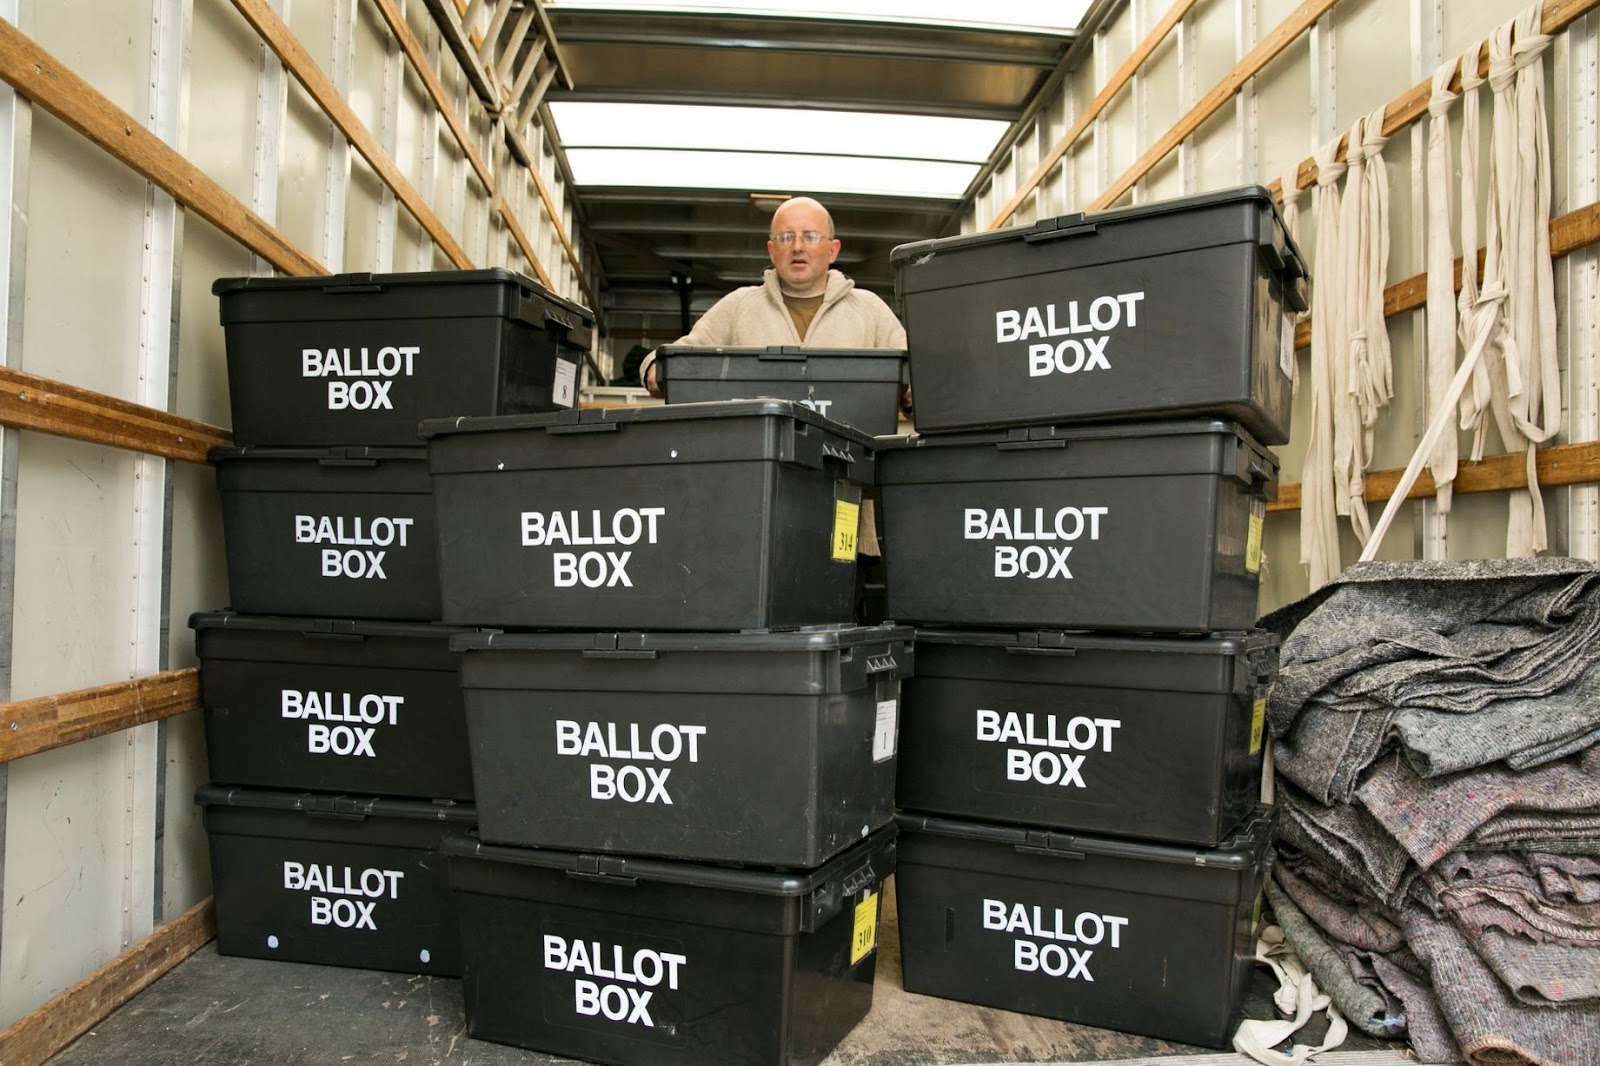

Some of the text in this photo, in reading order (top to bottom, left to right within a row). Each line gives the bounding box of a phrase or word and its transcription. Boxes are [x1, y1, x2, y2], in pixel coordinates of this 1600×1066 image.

[996, 292, 1144, 343] BALLOT
[303, 347, 420, 378] BALLOT
[1029, 336, 1111, 377] BOX
[329, 379, 393, 411] BOX
[295, 515, 413, 547] BALLOT
[521, 507, 666, 546] BALLOT
[839, 532, 853, 552] 314
[965, 507, 1108, 541] BALLOT
[322, 549, 386, 580] BOX
[554, 551, 633, 588] BOX
[995, 546, 1073, 580] BOX
[282, 690, 404, 725] BALLOT
[309, 724, 376, 757] BOX
[556, 720, 706, 763] BALLOT
[977, 710, 1121, 753] BALLOT
[590, 764, 674, 805] BOX
[1007, 749, 1086, 788] BOX
[284, 862, 404, 898] BALLOT
[312, 897, 377, 930] BOX
[984, 899, 1128, 948] BALLOT
[857, 925, 872, 951] 310
[544, 935, 686, 991] BALLOT
[1015, 940, 1094, 981] BOX
[576, 980, 654, 1027] BOX
